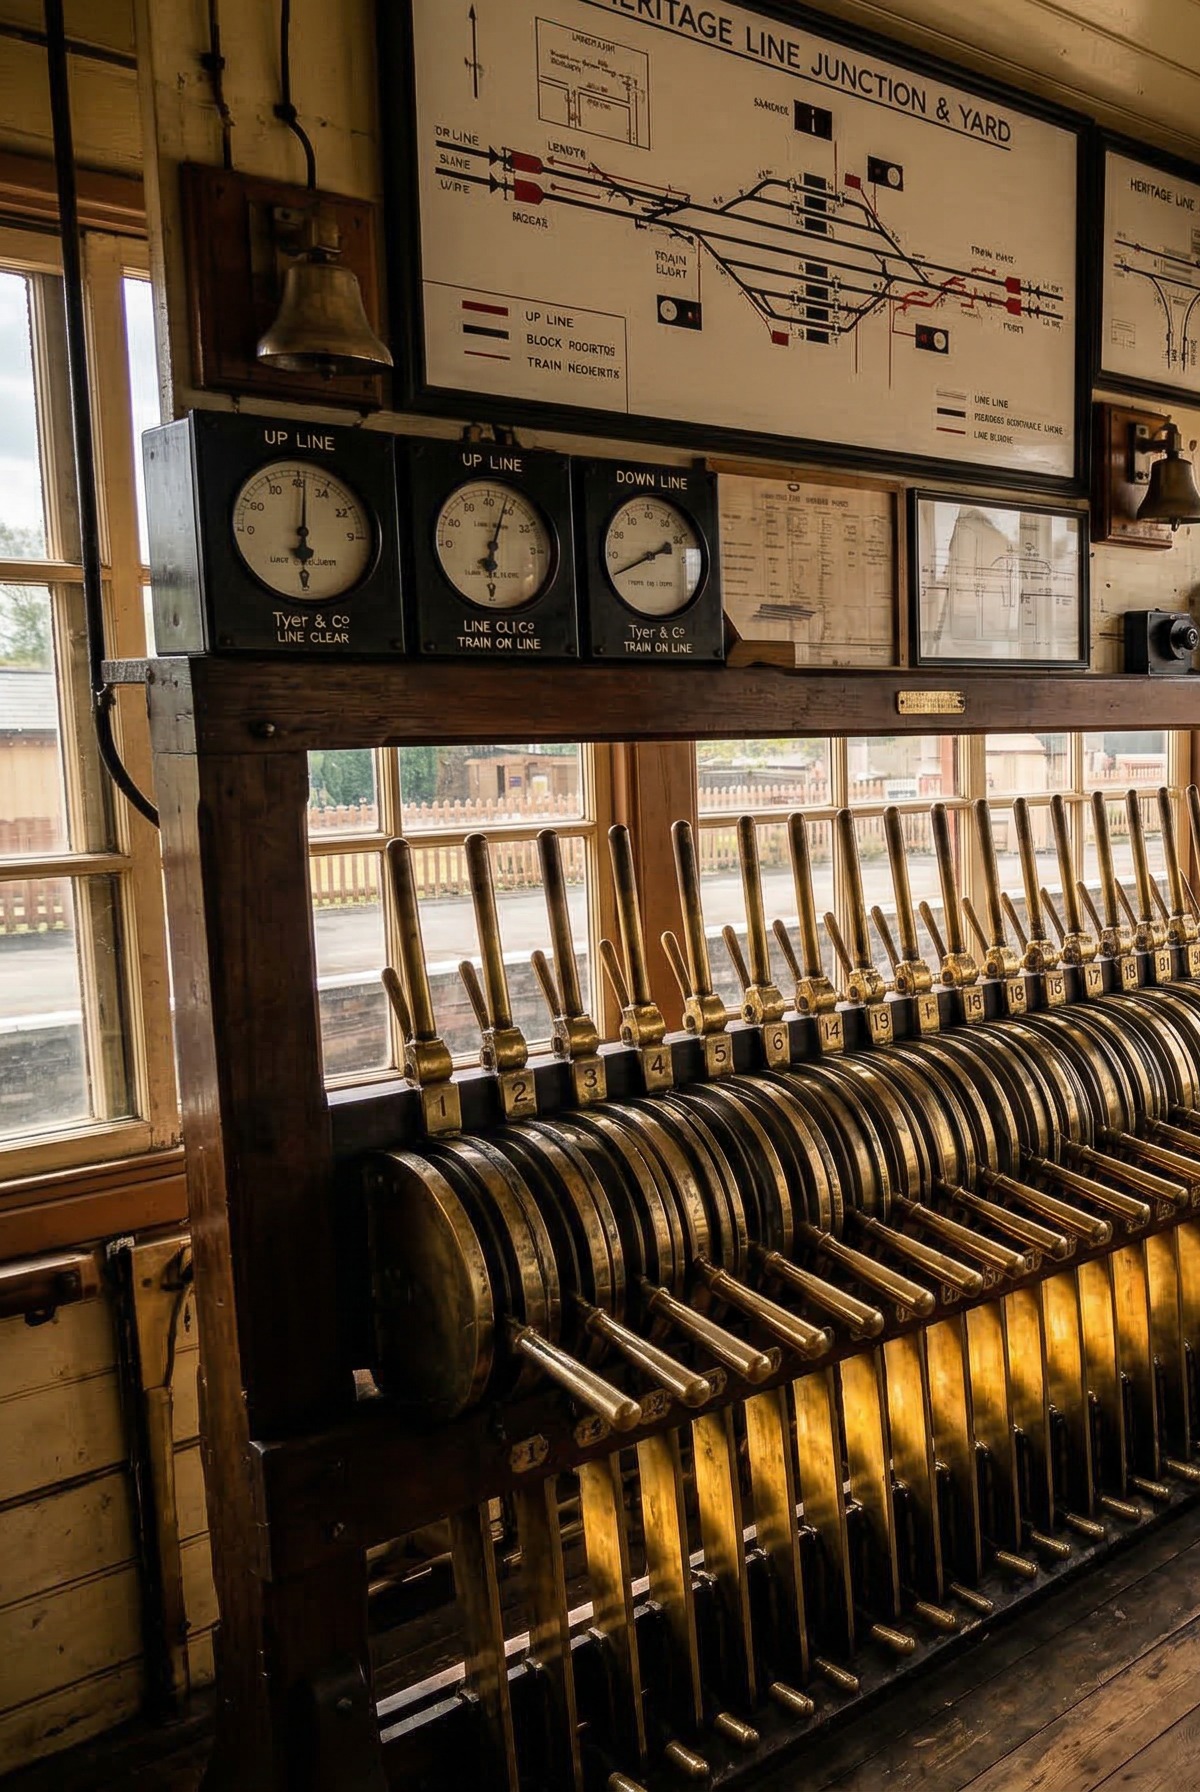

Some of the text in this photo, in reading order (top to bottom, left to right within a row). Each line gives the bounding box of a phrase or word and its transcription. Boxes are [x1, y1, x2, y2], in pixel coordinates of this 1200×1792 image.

[611, 0, 733, 46] RITAGE
[745, 25, 801, 68] LINE
[811, 53, 927, 113] JUNCTION
[936, 97, 950, 123] &
[957, 103, 1011, 142] YARD
[1130, 177, 1172, 203] HERITAGE
[525, 311, 574, 328] UP LINE
[526, 333, 562, 349] BLOCK
[527, 356, 562, 370] TRAIN
[265, 430, 336, 451] UP LINE
[462, 453, 523, 472] UP LINE
[616, 470, 688, 490] DOWN LINE
[273, 612, 308, 631] Tyer
[315, 614, 327, 629] &
[463, 620, 491, 633] LINE
[277, 632, 350, 645] LINE CLEAR
[628, 625, 656, 641] Tyer
[659, 626, 668, 639] &
[457, 637, 541, 650] TRAIN ON LINE
[624, 641, 693, 654] TRAIN ON LINE
[1088, 969, 1101, 985] 17
[825, 1021, 841, 1040] 14
[772, 1032, 784, 1051] 6
[714, 1044, 727, 1063] 5
[651, 1055, 665, 1075] 4
[584, 1068, 598, 1088] 3
[512, 1081, 527, 1102] 2
[438, 1094, 446, 1117] 1
